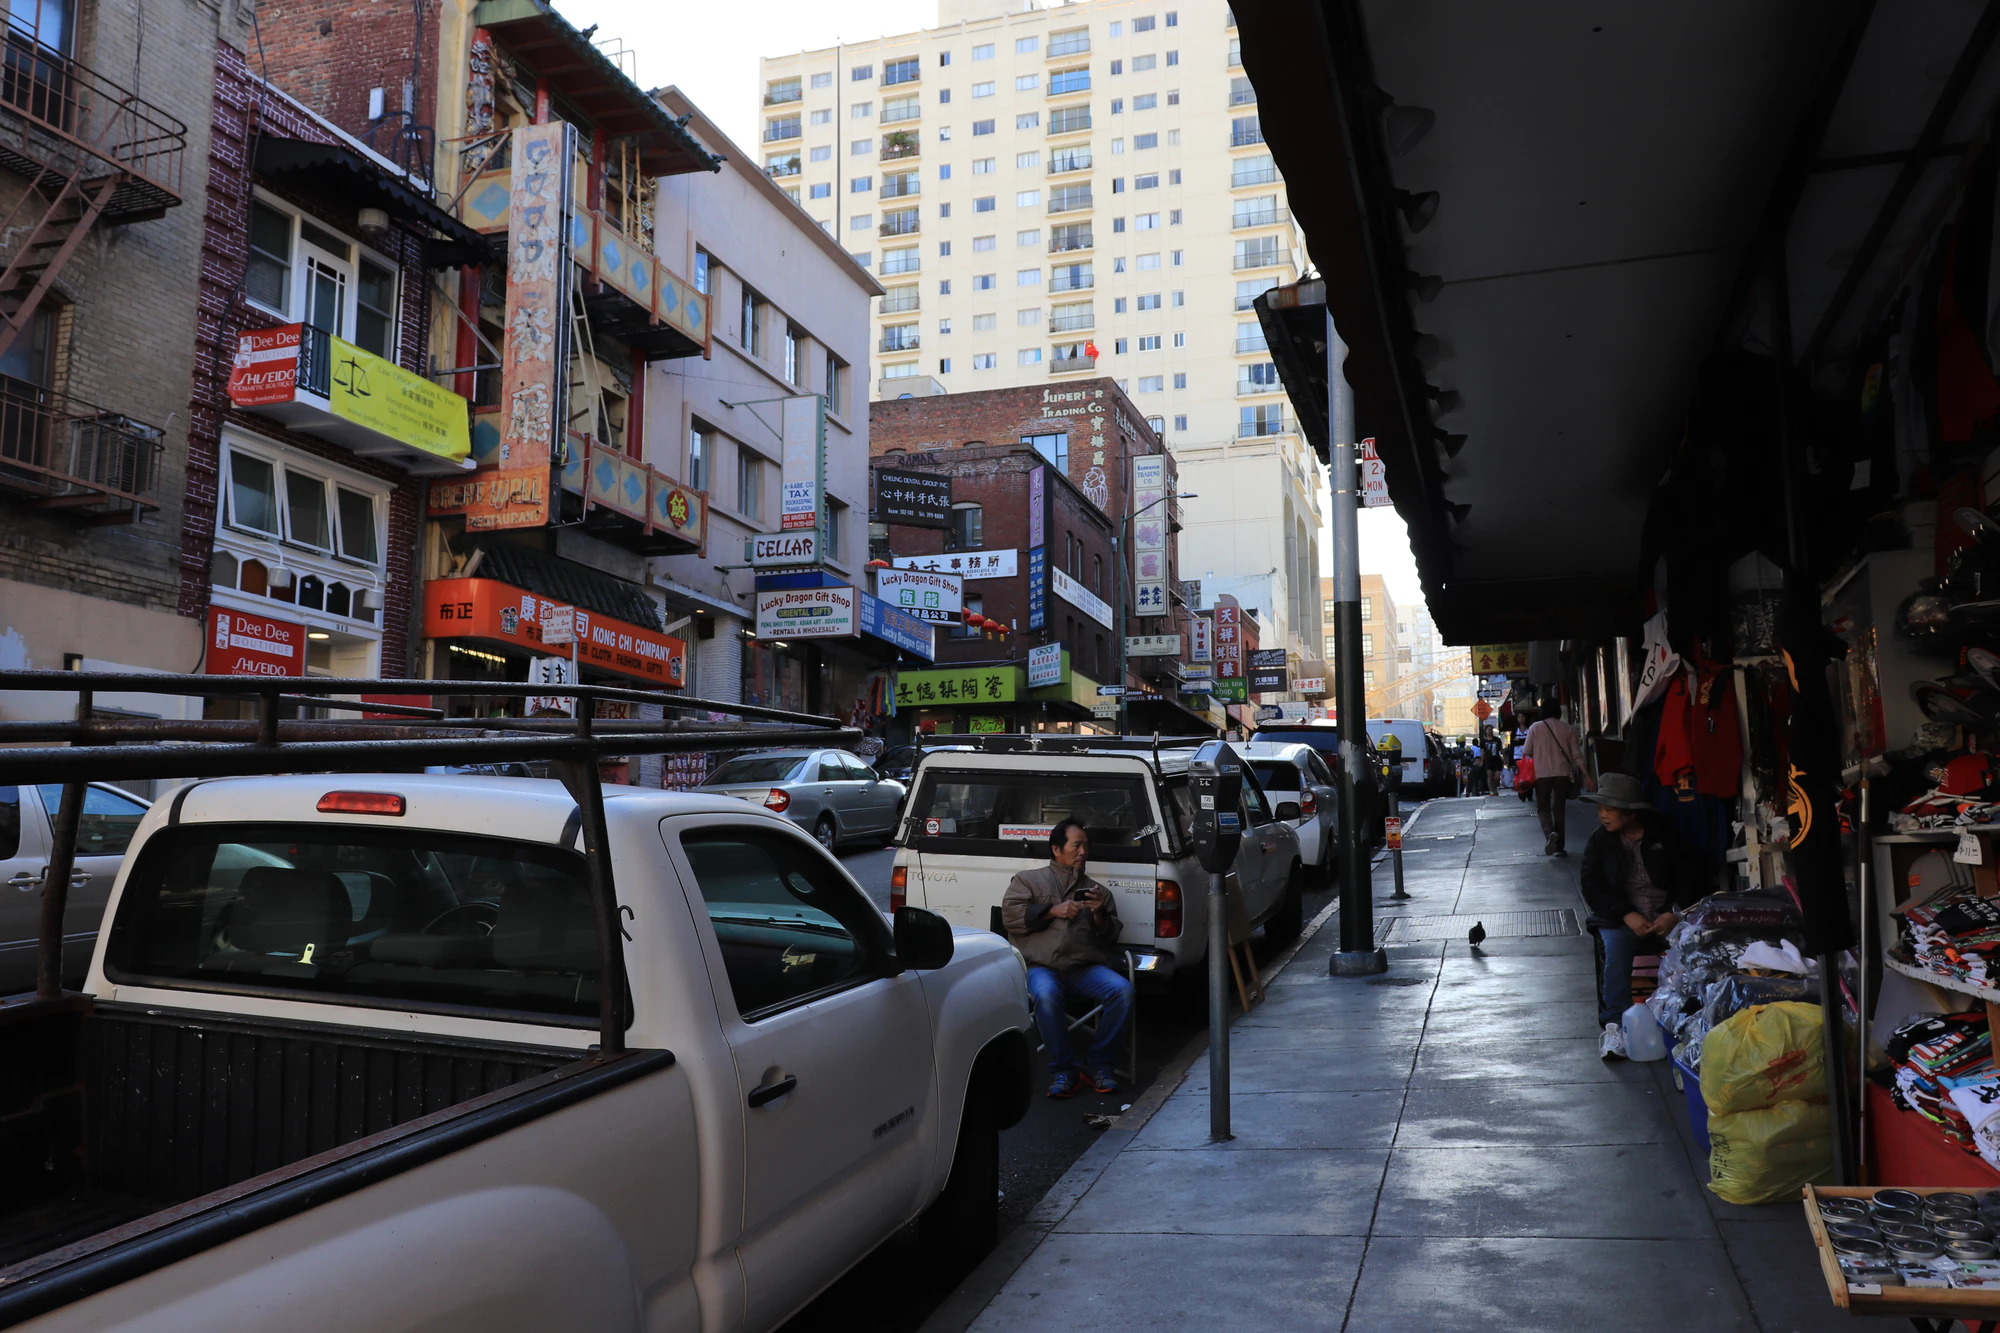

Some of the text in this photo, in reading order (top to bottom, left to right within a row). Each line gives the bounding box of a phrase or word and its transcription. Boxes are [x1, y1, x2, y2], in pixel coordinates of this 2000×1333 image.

[253, 332, 299, 348] Dee Dee
[232, 368, 296, 386] SHISEIDO
[378, 365, 391, 376] Law
[1041, 406, 1086, 418] TRADING
[1365, 442, 1380, 459] N
[882, 475, 903, 483] CHEUNG
[904, 477, 921, 485] DENTAL
[1367, 481, 1383, 491] MON
[430, 482, 486, 509] GREAT
[788, 489, 809, 498] TAX
[670, 494, 686, 520] 飯
[468, 508, 544, 528] RESTAURANT
[756, 538, 813, 558] CELLAR
[882, 573, 958, 595] Lucky Dragon Gift Shop
[760, 596, 783, 612] Lucky
[786, 593, 813, 604] Dragon
[815, 592, 829, 602] Gift
[832, 594, 850, 609] Shop
[544, 608, 571, 618] NO PARKING
[778, 606, 831, 617] ORIENTAL GIFTS
[236, 617, 290, 642] Dee Dee
[881, 624, 897, 643] Lucky
[897, 632, 915, 649] Dragon
[916, 640, 925, 653] Gift
[234, 636, 289, 654] BOUTIQUE
[592, 626, 616, 648] KONG
[618, 634, 632, 651] CHI
[635, 638, 670, 662] COMPANY
[231, 657, 286, 676] SHISEIDO
[592, 647, 612, 662] CLOTH
[617, 653, 642, 670] FASHION
[646, 662, 663, 676] GIFTS
[896, 674, 1003, 703] 景德鎮陶瓷
[909, 872, 958, 882] TOYOTA
[1107, 880, 1154, 889] TACOMA
